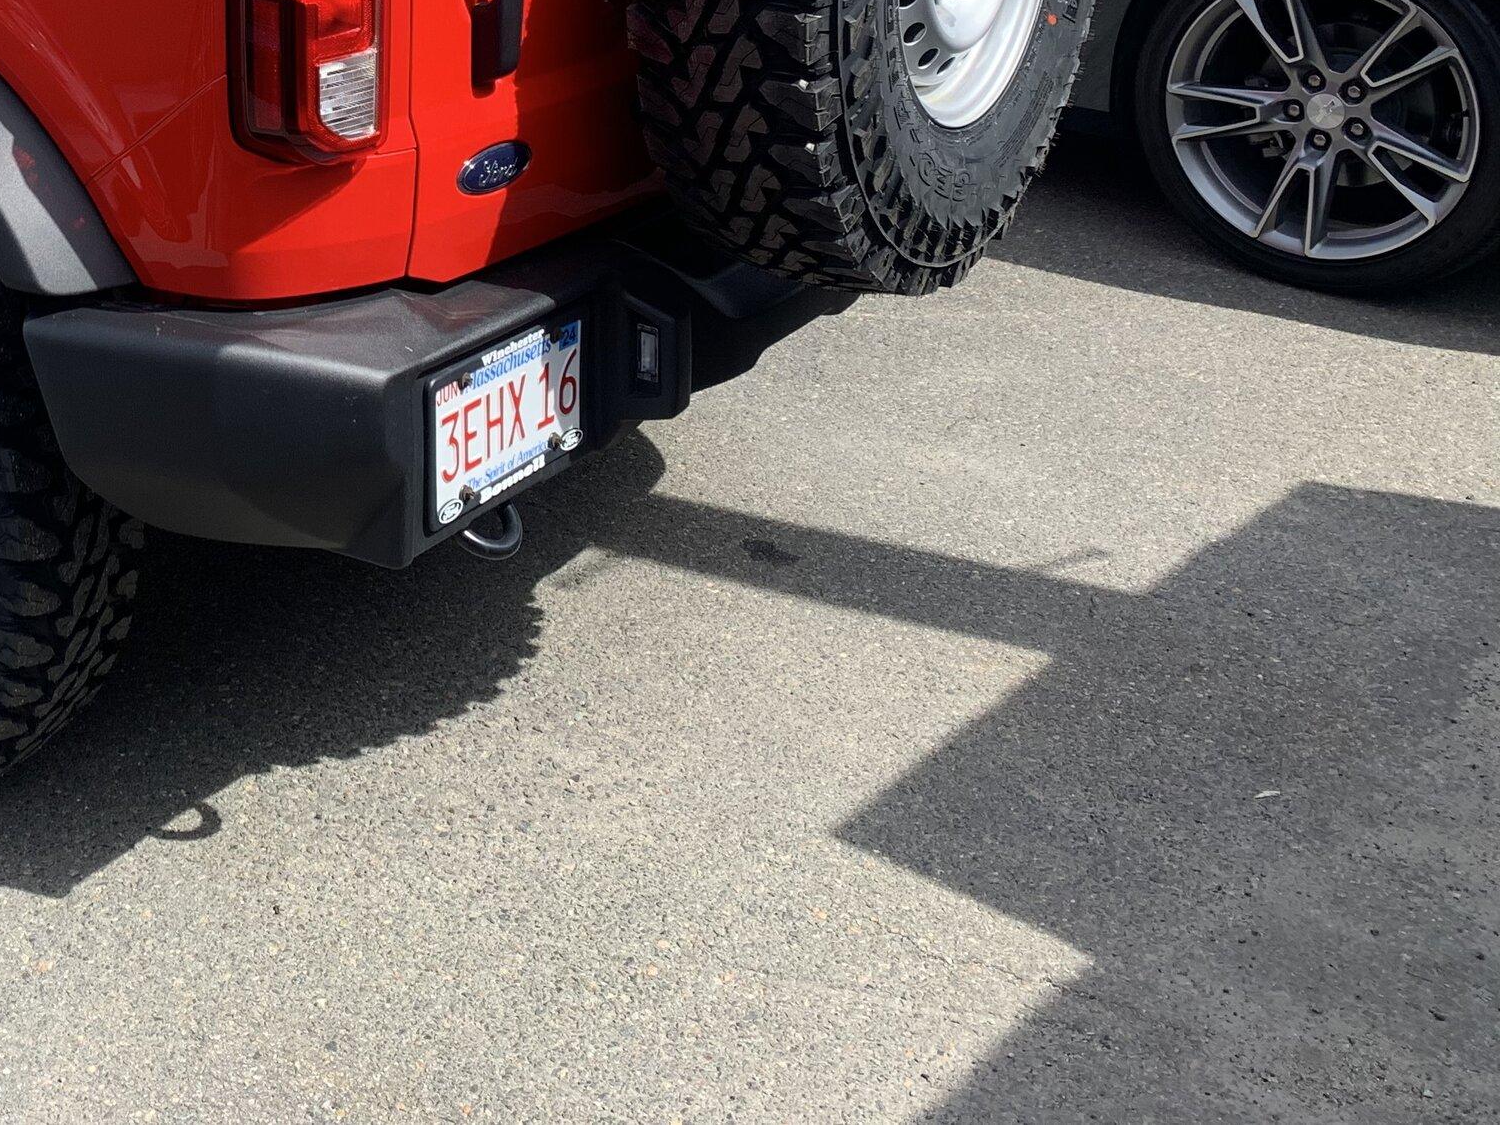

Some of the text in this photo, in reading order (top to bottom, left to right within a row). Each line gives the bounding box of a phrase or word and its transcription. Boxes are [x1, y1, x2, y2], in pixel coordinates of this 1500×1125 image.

[481, 328, 545, 366] Winchester
[437, 381, 460, 407] JUN
[441, 348, 577, 484] 3EHX 16
[485, 462, 505, 483] Spirit
